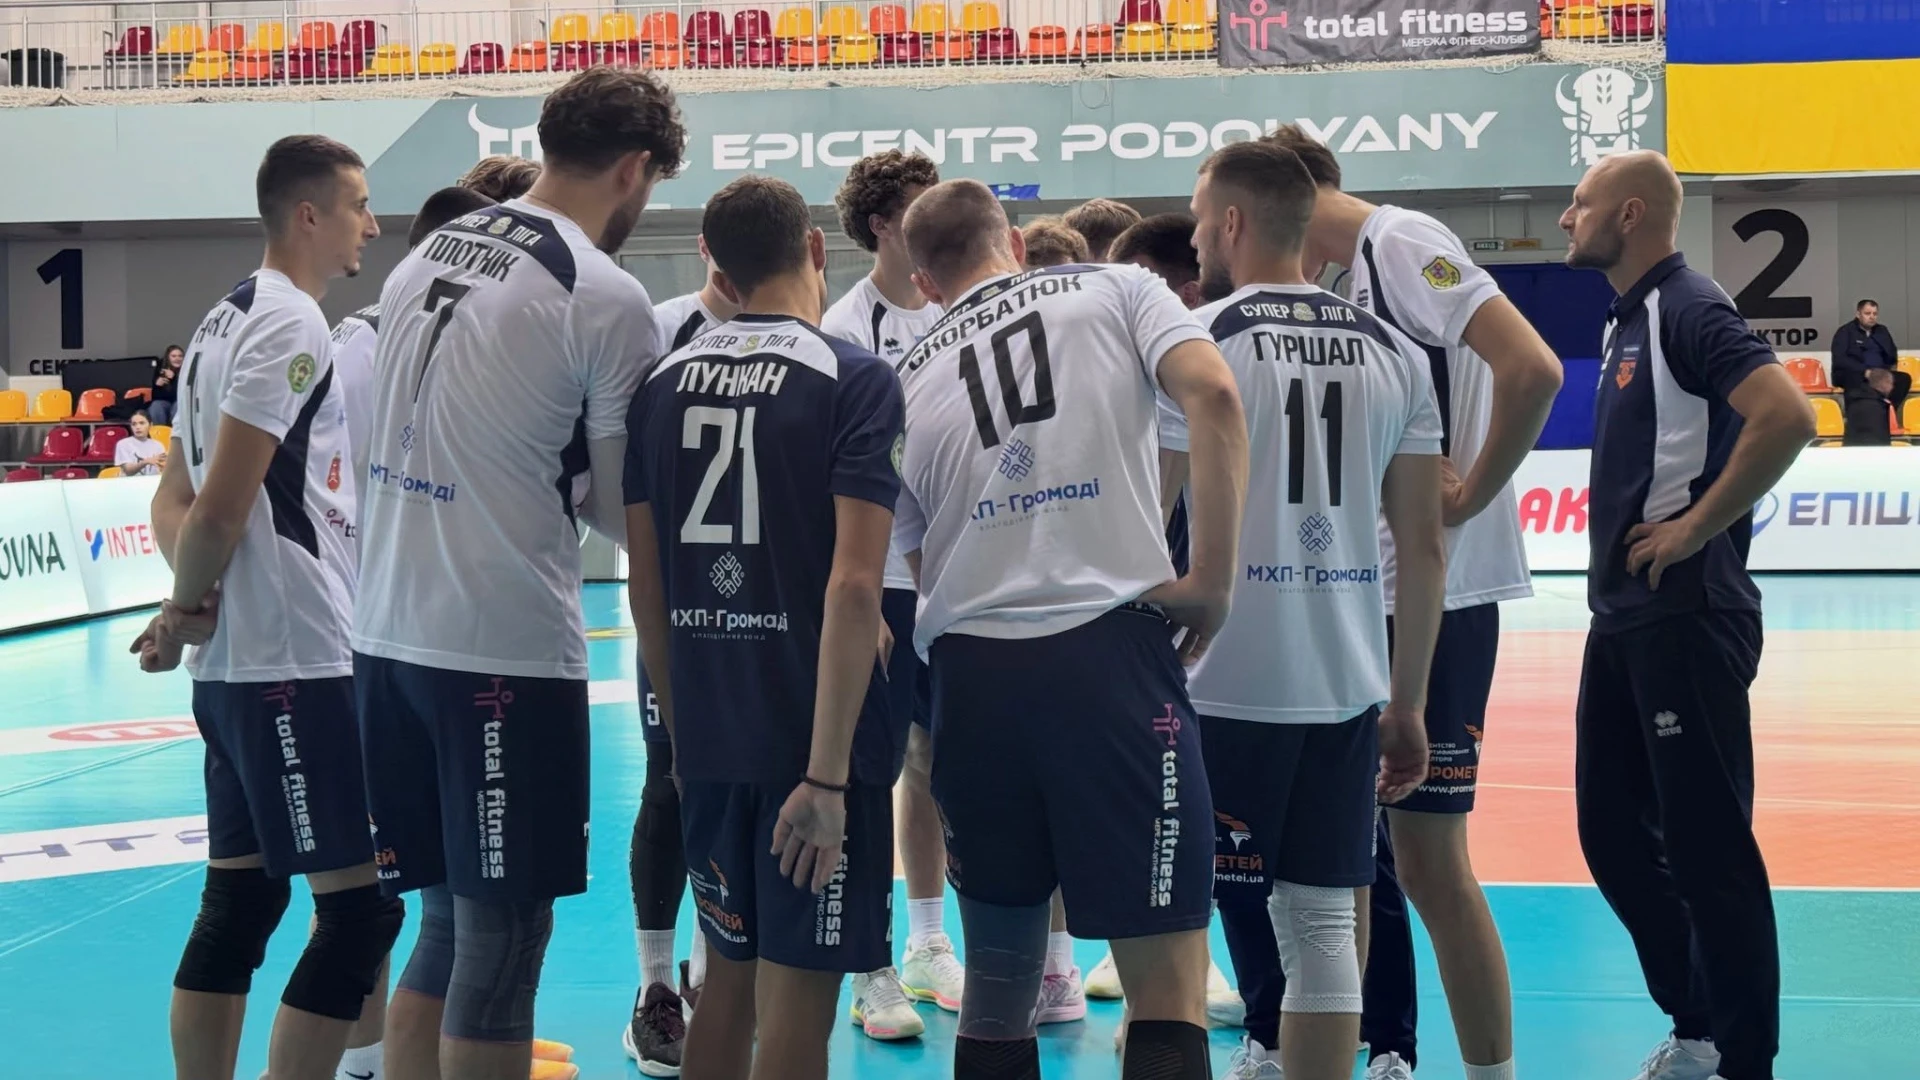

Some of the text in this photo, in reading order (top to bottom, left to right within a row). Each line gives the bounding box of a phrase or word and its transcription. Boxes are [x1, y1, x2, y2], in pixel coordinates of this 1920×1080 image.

[1303, 9, 1528, 39] total fitness
[1402, 35, 1527, 48] МЕРЕЖА ФІТНЕС-КЛУБІВ
[1061, 111, 1498, 161] PODOYANY
[507, 225, 543, 246] ЛІГА
[422, 233, 520, 282] ПЛОТНІК
[1732, 209, 1812, 318] 2
[37, 249, 83, 349] 1
[1239, 303, 1357, 322] СУПЕР ЛІГА
[413, 277, 472, 404] 7
[908, 275, 1082, 371] СКОРБАТЮК
[1751, 328, 1818, 346] КТОР
[690, 334, 799, 351] СУПЕР ЛІГА
[1252, 331, 1365, 366] ГУРШАЛ
[676, 361, 788, 397] ЛУНКАН
[958, 310, 1056, 449] 10
[1285, 378, 1342, 507] 11
[680, 406, 760, 545] 21
[972, 478, 1100, 520] П-Громаді
[1788, 491, 1920, 526] ЕПІЦ
[106, 524, 157, 558] INTE
[1247, 564, 1378, 585] МХП-Громаді
[275, 714, 316, 852] total fitness
[1430, 766, 1478, 779] РОМЕТ
[484, 720, 506, 879] total fitness
[1158, 750, 1180, 907] total fitness
[1214, 853, 1263, 871] ЕТЕЙ
[1214, 872, 1264, 883] metei.ua
